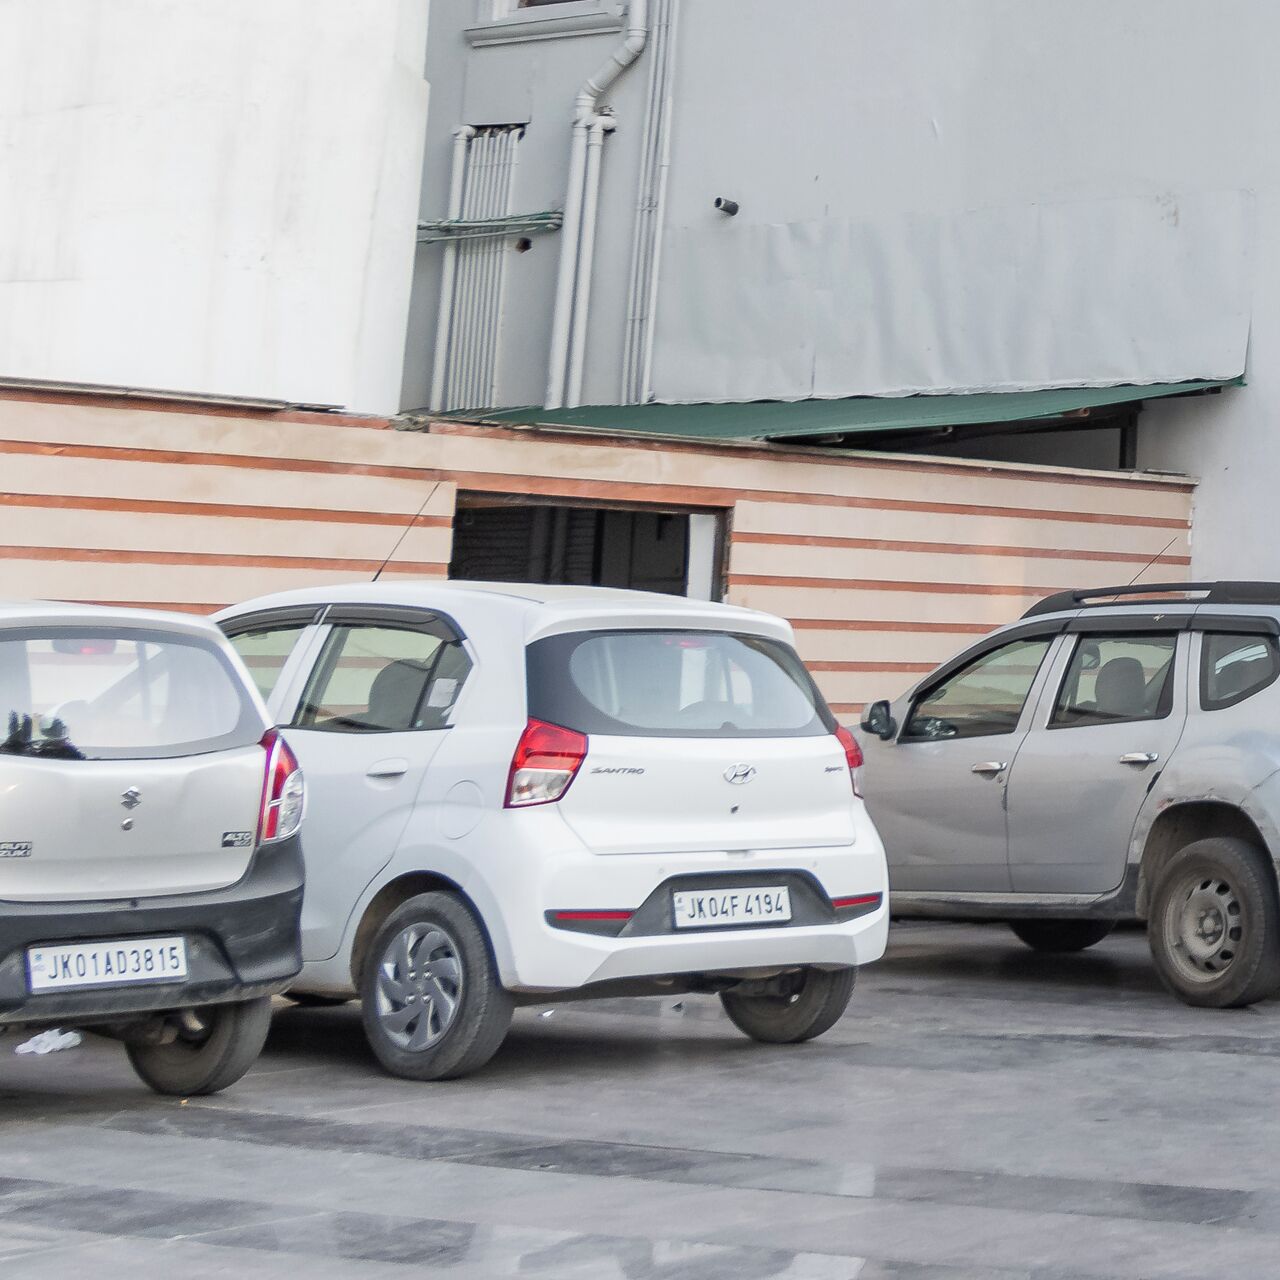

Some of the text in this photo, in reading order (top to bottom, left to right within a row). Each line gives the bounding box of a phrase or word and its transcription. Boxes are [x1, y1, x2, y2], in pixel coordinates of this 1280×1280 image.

[688, 893, 783, 919] JK04F 4194
[48, 946, 180, 979] JK01AD3815
